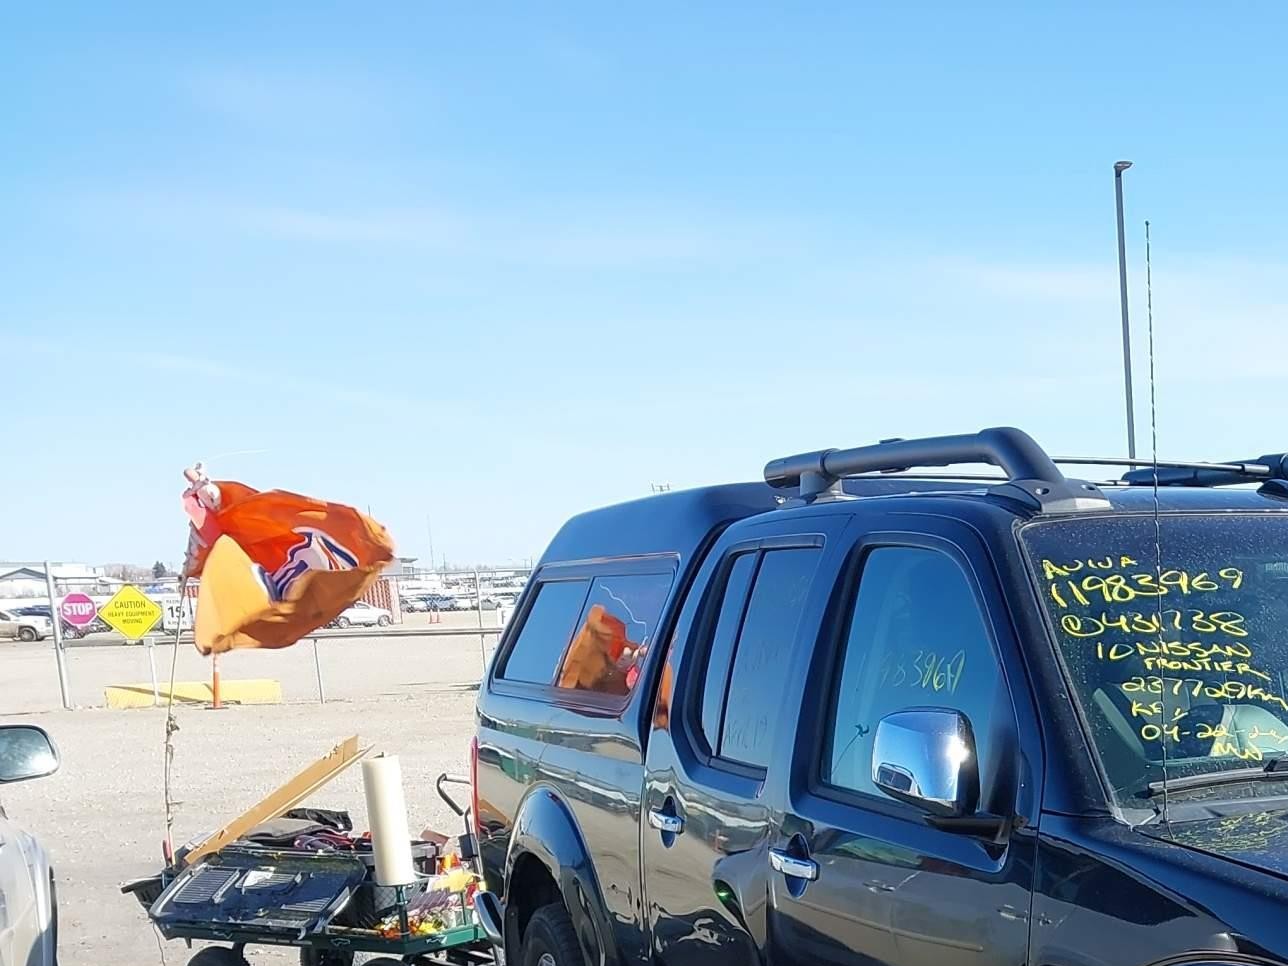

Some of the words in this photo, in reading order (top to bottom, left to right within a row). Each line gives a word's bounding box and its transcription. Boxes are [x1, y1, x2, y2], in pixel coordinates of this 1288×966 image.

[1051, 567, 1243, 608] 11983969
[64, 604, 93, 616] STOP
[114, 601, 146, 609] CAUTION
[1144, 658, 1273, 682] FRONTIER
